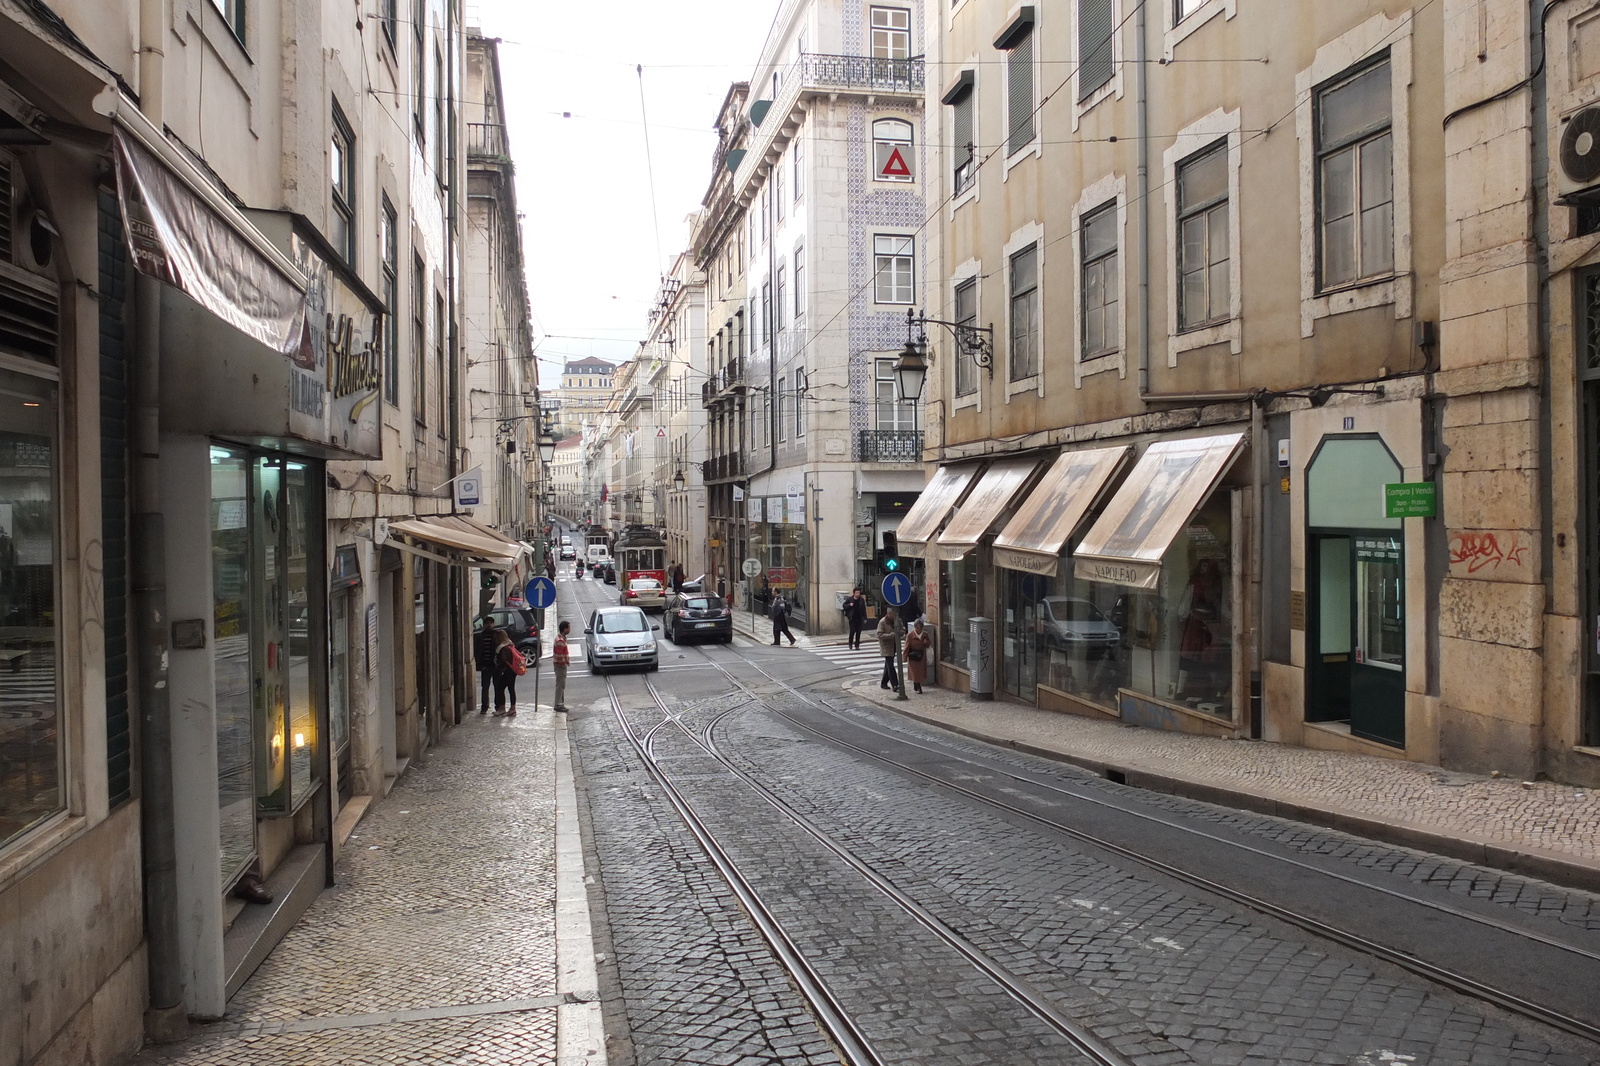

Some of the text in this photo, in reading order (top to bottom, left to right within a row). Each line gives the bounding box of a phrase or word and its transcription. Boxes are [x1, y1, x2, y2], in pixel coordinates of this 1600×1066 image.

[1345, 417, 1353, 429] 10
[1387, 487, 1435, 497] Compro Vendo
[1008, 554, 1042, 571] NAPOLEÃO
[1094, 565, 1137, 583] NAPOLEÃO
